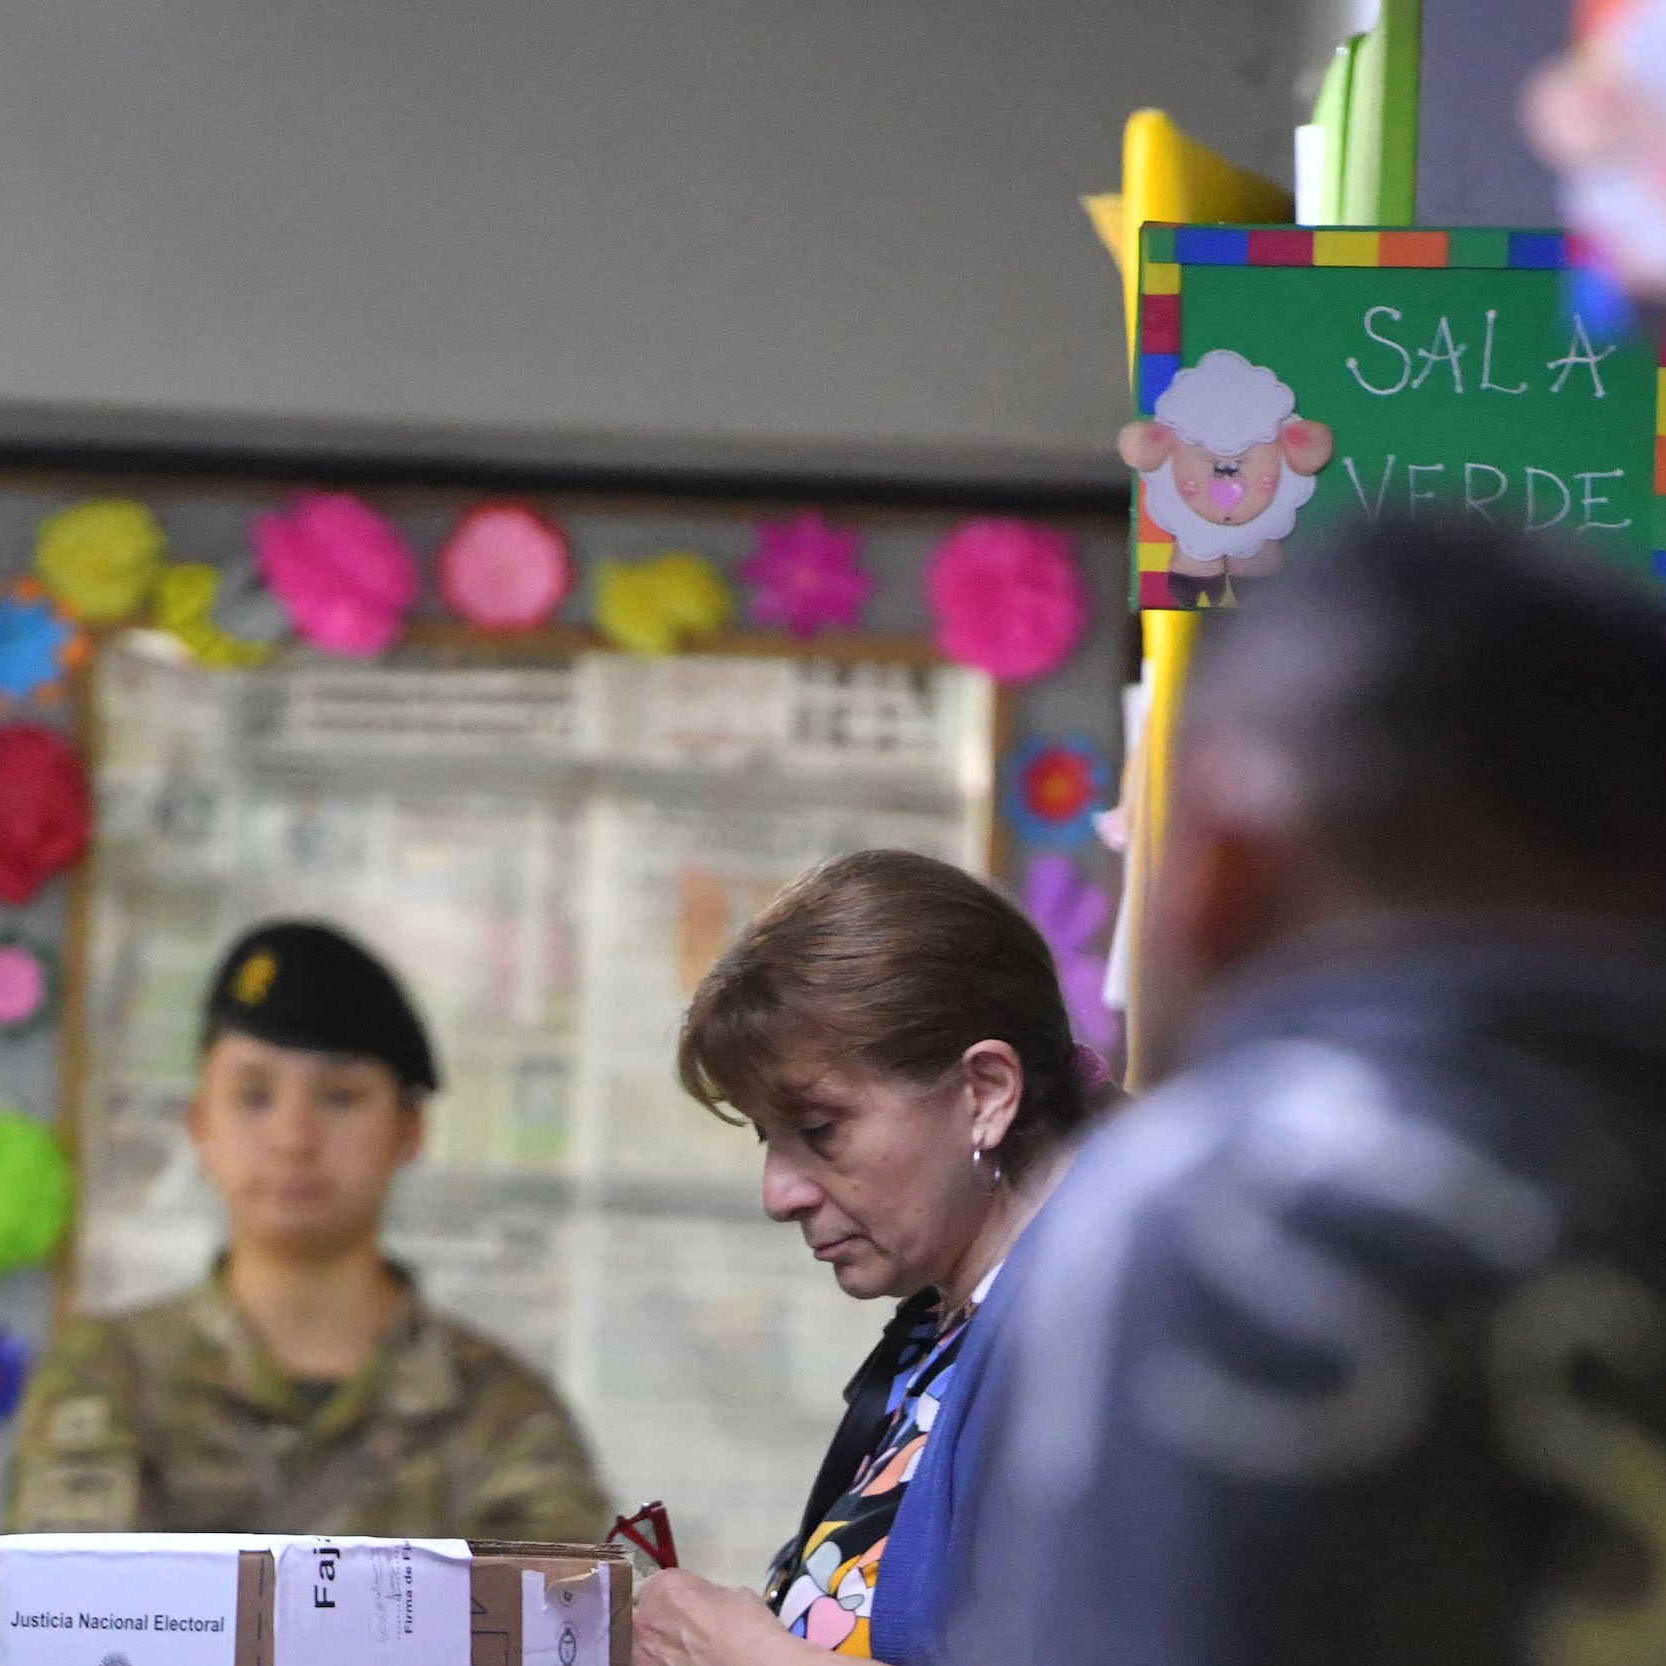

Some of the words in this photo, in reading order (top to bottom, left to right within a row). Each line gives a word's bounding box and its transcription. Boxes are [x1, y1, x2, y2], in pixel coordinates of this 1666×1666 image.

[1346, 305, 1616, 398] SALA
[1342, 453, 1632, 532] VERDE
[313, 1538, 341, 1609] Faj
[10, 1610, 74, 1629] Justicia
[78, 1612, 149, 1631] Nacional
[153, 1614, 225, 1633] Electoral
